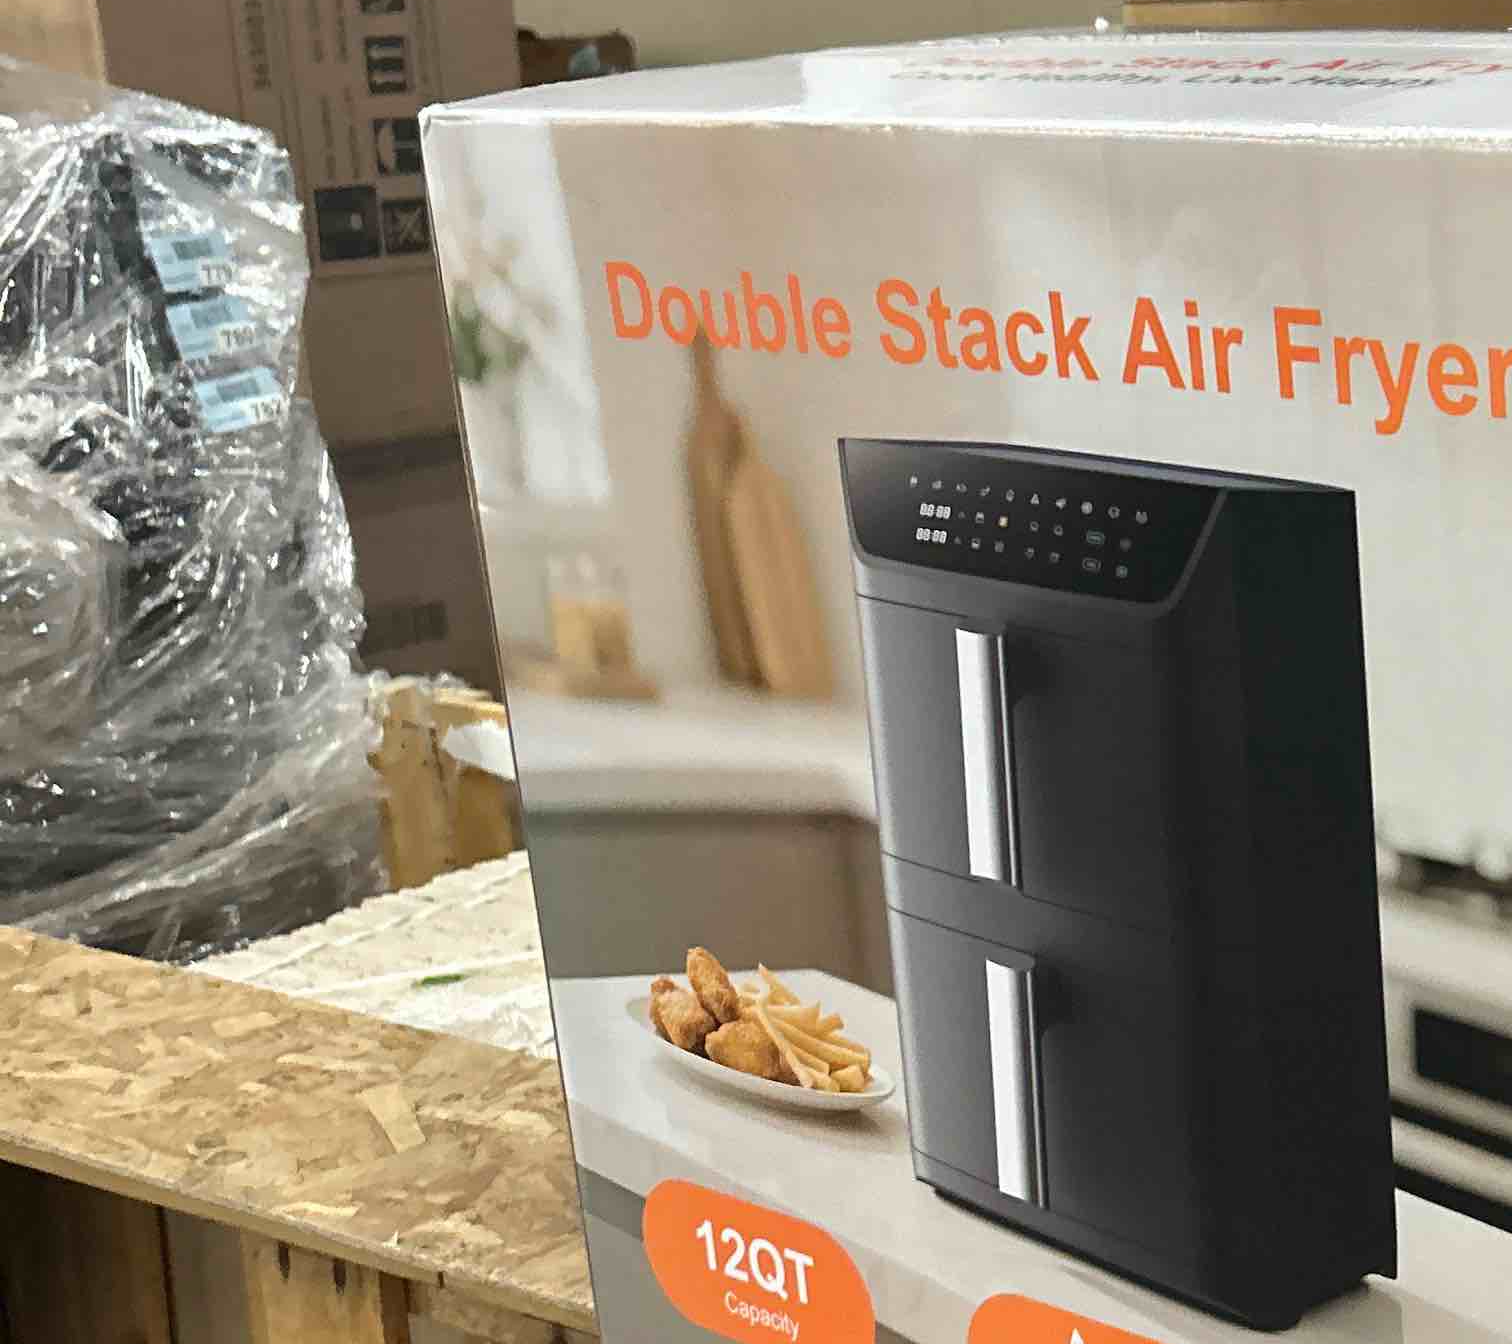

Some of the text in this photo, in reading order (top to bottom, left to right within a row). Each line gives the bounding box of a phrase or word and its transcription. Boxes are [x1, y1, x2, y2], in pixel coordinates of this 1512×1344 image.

[1289, 75, 1445, 89] Happy
[605, 260, 851, 358] Double
[876, 278, 1100, 381] Stack
[1122, 296, 1243, 394] Air
[696, 1219, 814, 1305] 12QT
[724, 1292, 799, 1342] Capacity
